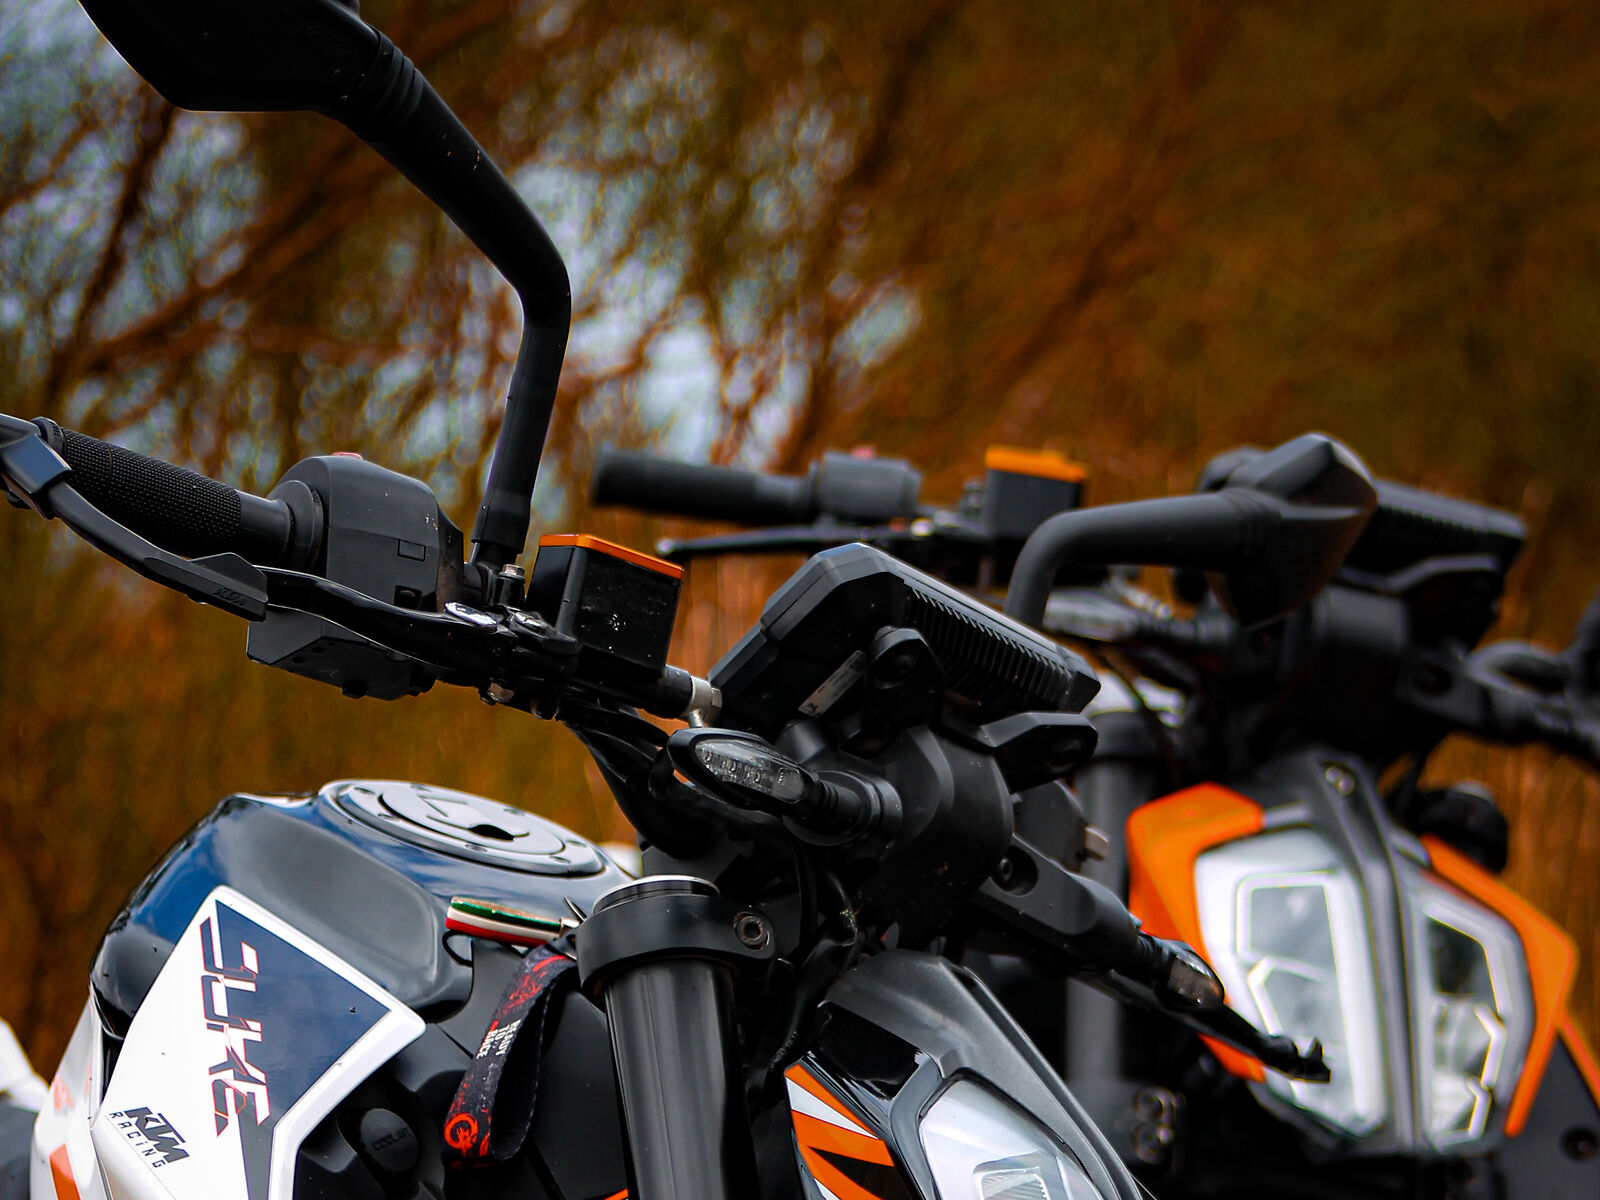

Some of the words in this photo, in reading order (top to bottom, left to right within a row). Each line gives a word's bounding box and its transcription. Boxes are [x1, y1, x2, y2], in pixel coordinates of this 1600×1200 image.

[200, 917, 271, 1137] DUKE
[476, 1029, 499, 1060] RACE
[494, 1024, 510, 1041] TO
[496, 1019, 521, 1056] READY
[123, 1106, 190, 1164] KTM
